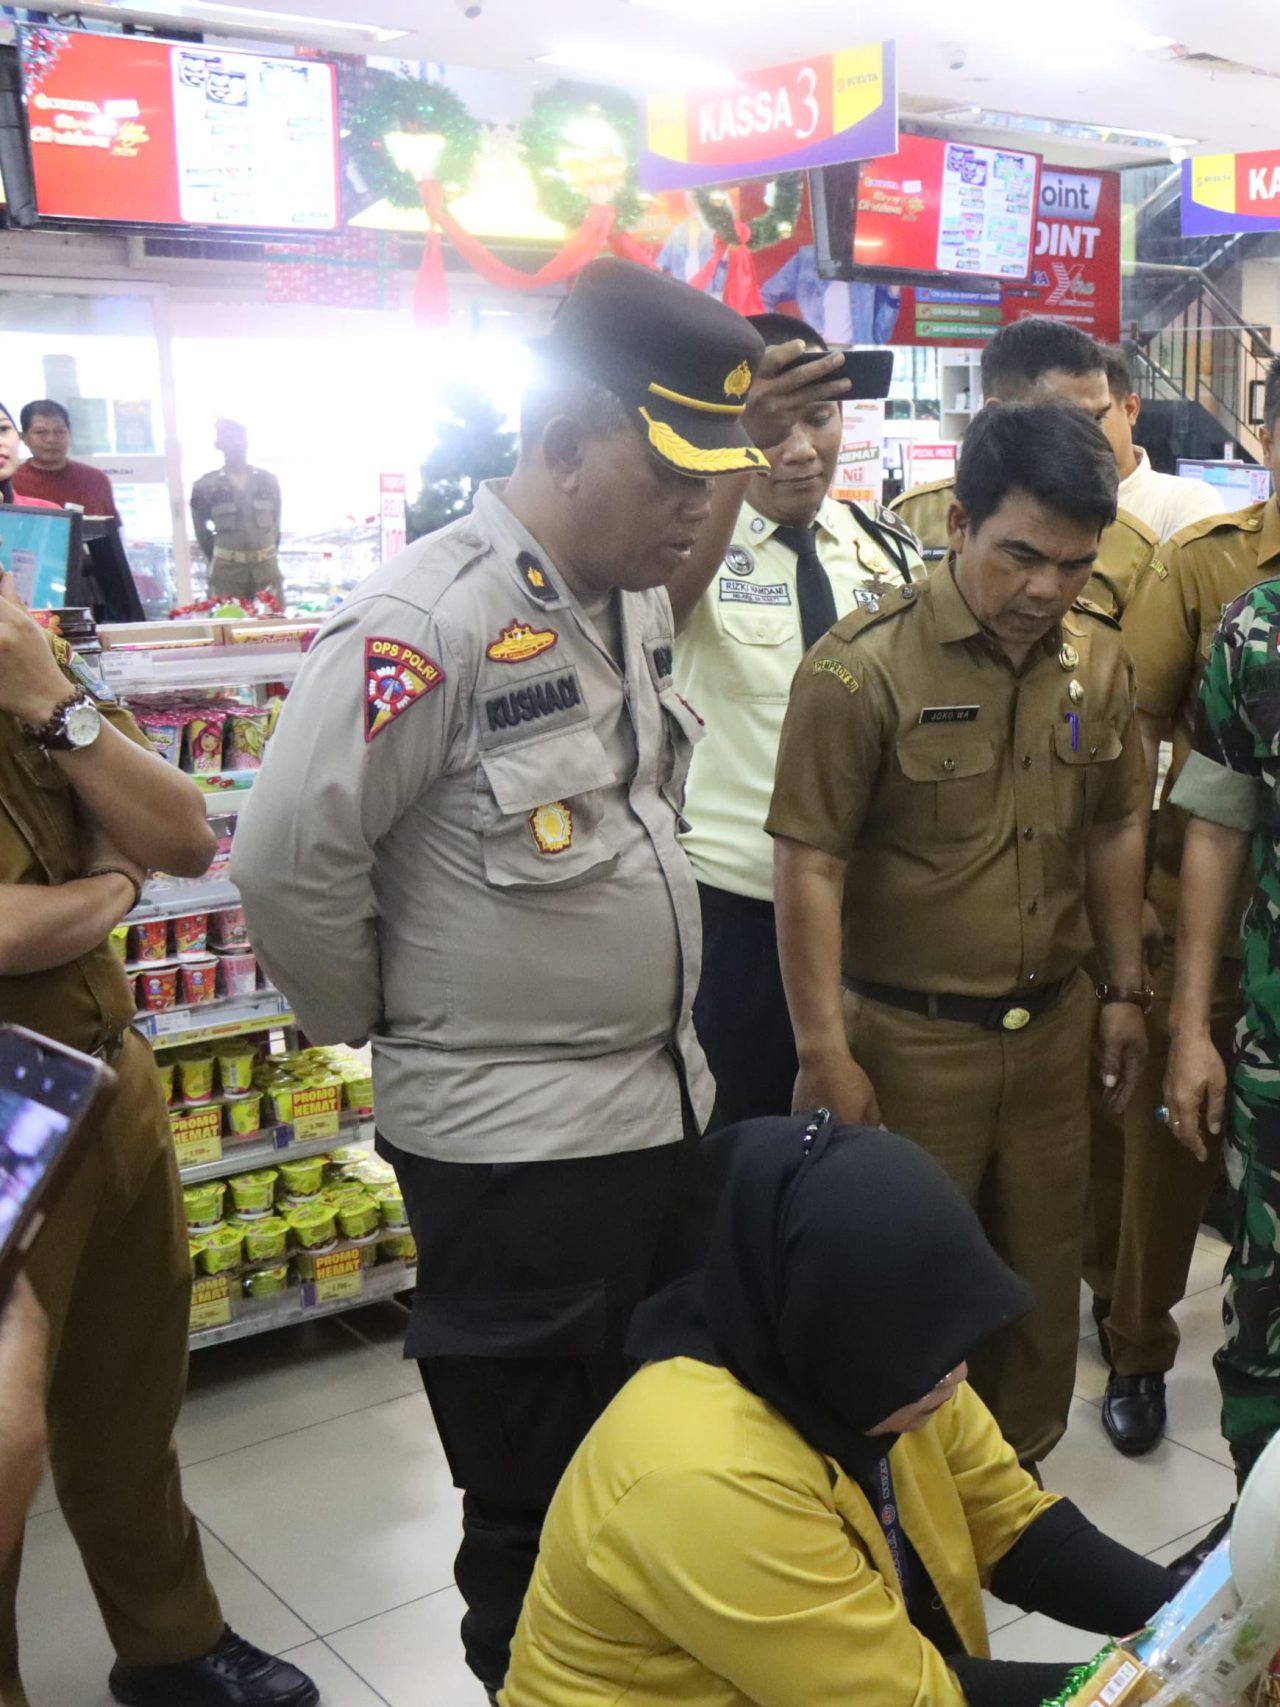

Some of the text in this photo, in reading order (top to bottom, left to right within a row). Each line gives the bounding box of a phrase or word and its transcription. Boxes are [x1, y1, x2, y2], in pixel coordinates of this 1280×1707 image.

[700, 67, 818, 144] KASSA 3
[1042, 179, 1090, 209] oint
[1035, 221, 1101, 259] OINT
[726, 582, 749, 592] RIZKI
[372, 640, 438, 681] OPS POLRI
[485, 674, 581, 732] KUSNADI
[930, 712, 953, 721] JOKO
[294, 1088, 336, 1104] PROMO
[295, 1099, 337, 1117] HEMAT
[171, 1114, 217, 1132] PROMO
[173, 1125, 219, 1145] HEMAT
[316, 1248, 359, 1268] PROMO
[317, 1259, 360, 1279] HEMAT
[192, 1286, 228, 1304] EMAT
